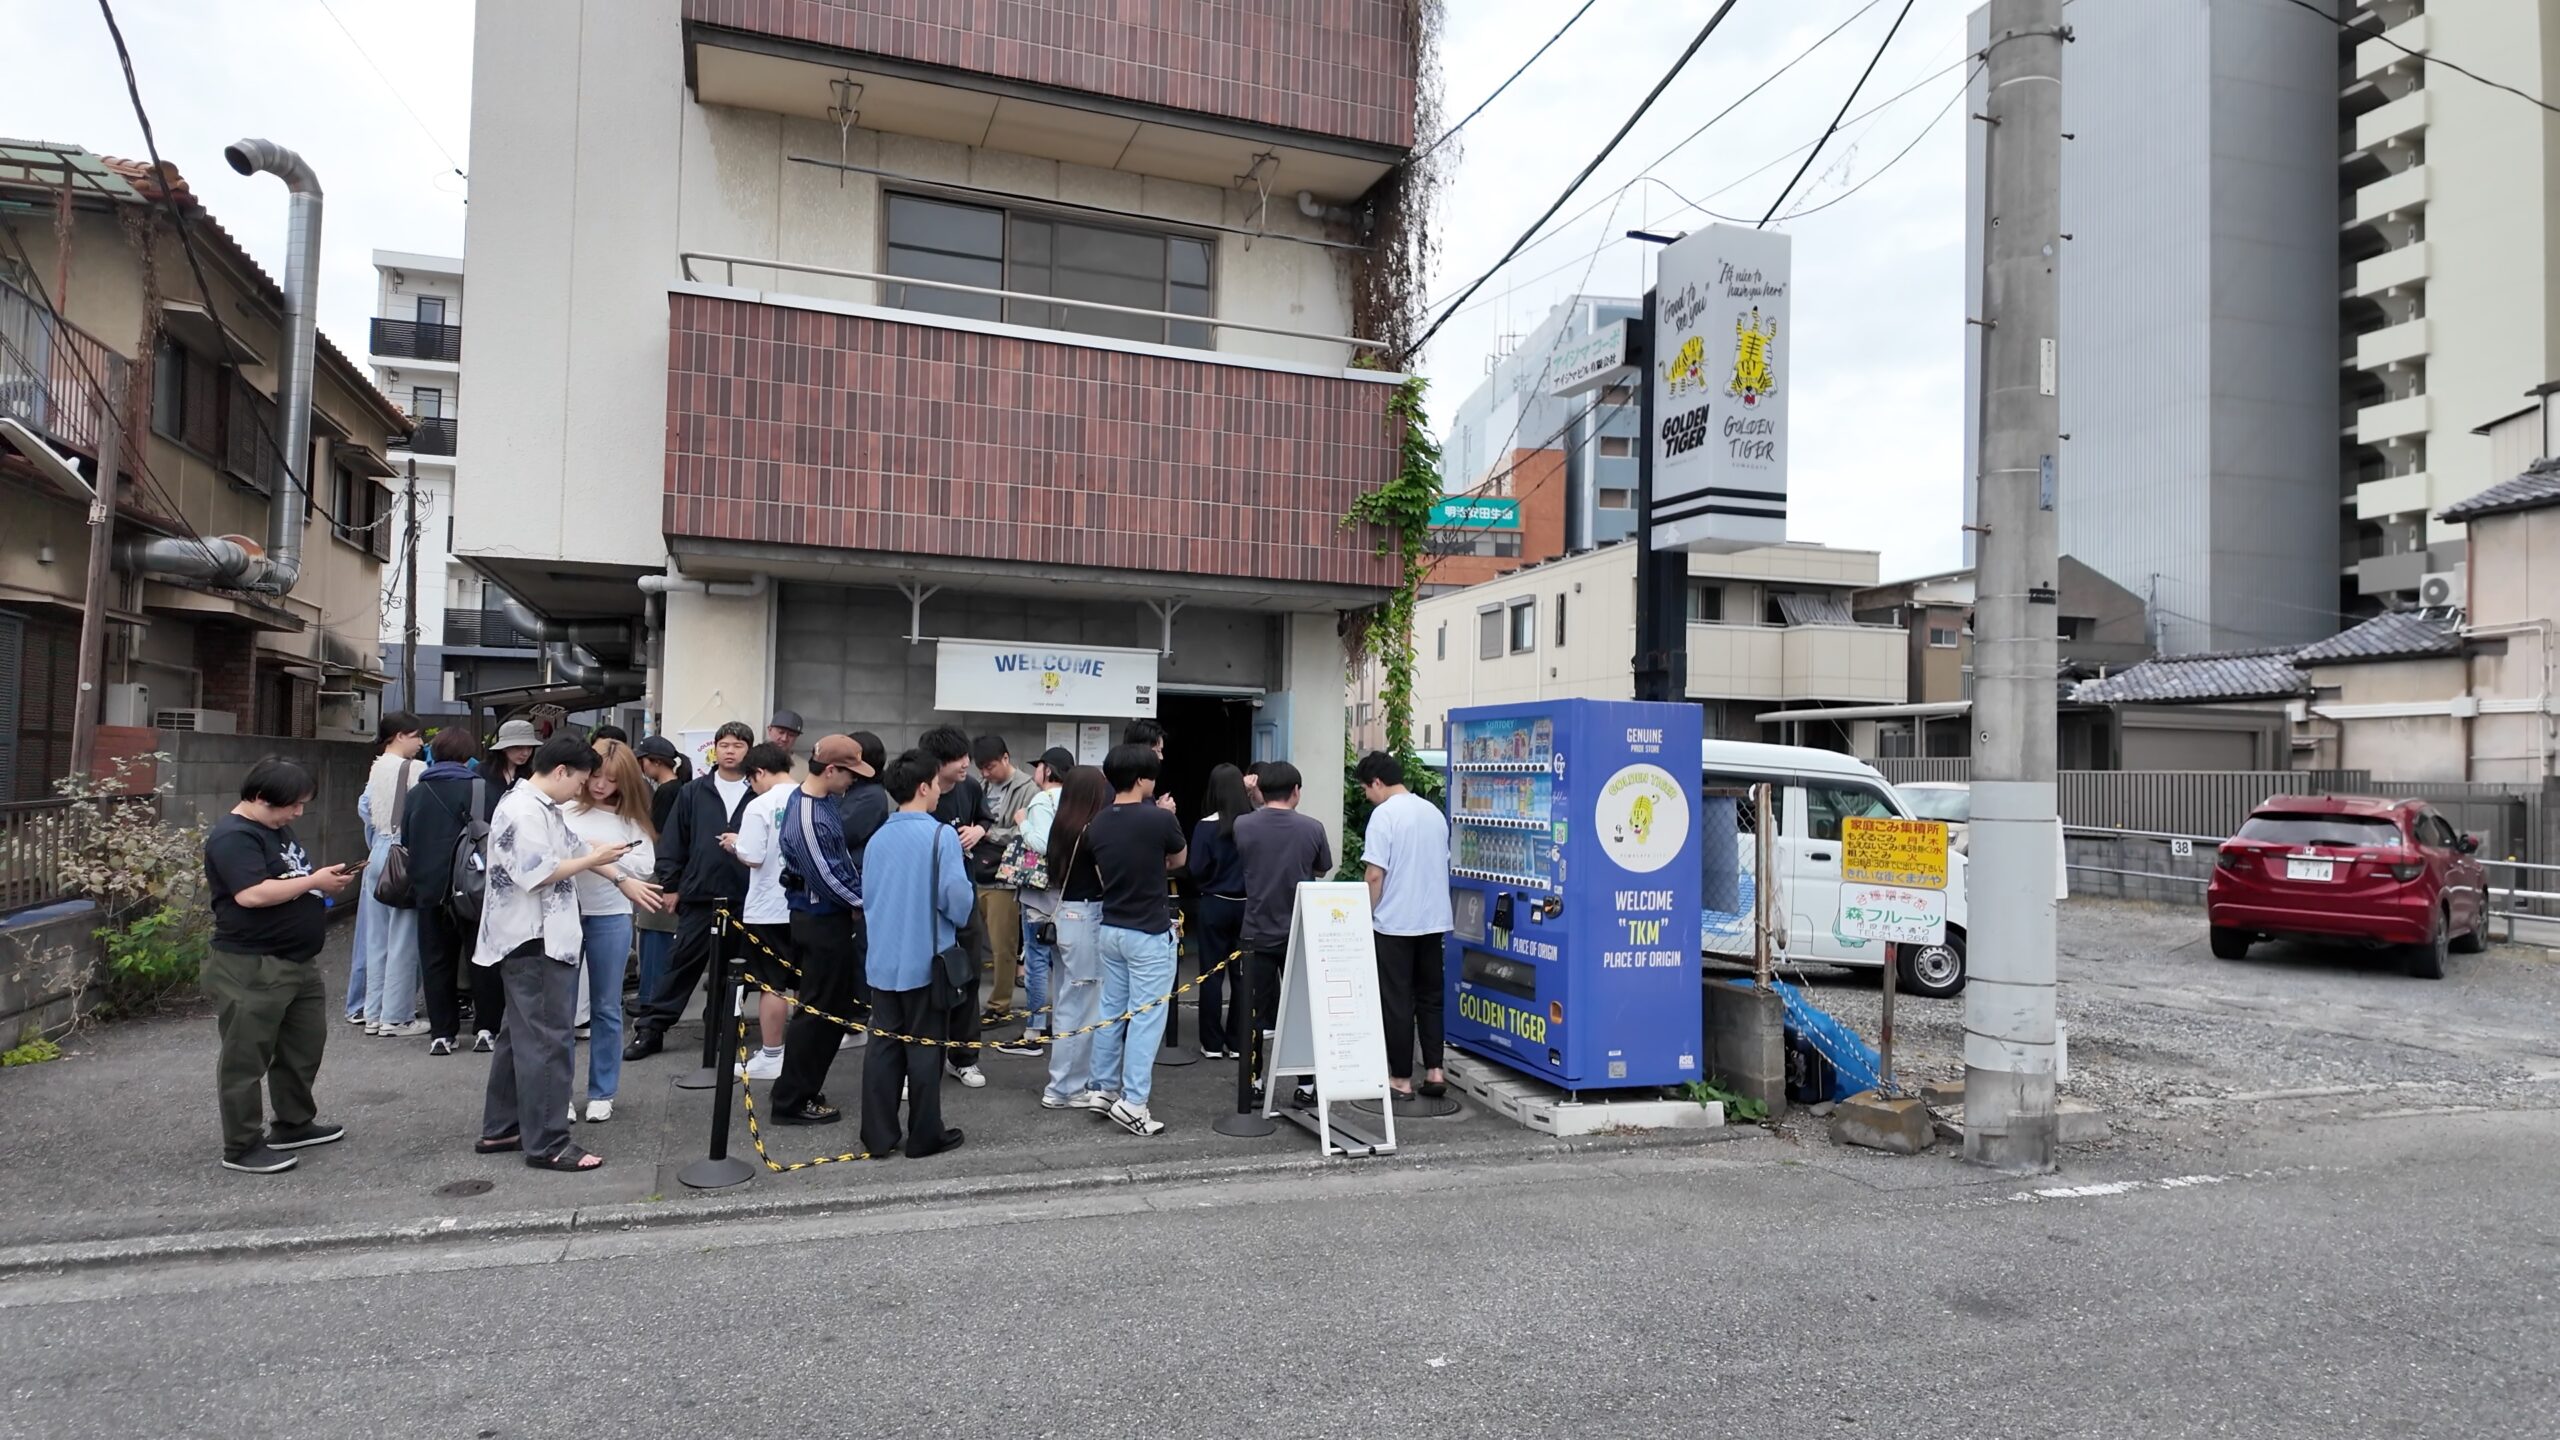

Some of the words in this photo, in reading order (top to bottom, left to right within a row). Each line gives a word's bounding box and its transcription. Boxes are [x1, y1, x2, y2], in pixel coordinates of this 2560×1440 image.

[1735, 268, 1752, 282] nice
[1753, 268, 1762, 283] to
[1687, 281, 1696, 307] to
[1662, 403, 1710, 440] GOLDEN
[1723, 416, 1774, 437] GOLDEN
[1665, 425, 1706, 459] TIGER
[1729, 438, 1775, 462] TIGER
[995, 653, 1105, 678] WELCOME
[1626, 727, 1663, 744] GENUINE
[1608, 772, 1649, 796] GOLDEN
[1651, 773, 1678, 800] TIGER
[1847, 832, 1896, 842] もえるごみ
[1850, 820, 1939, 835] 家庭ごみ集積所
[1847, 841, 1898, 851] もえないごみ
[1847, 850, 1891, 860] 粗大ごみ
[1907, 853, 1917, 861] 火
[2175, 841, 2188, 854] 38
[1615, 890, 1674, 911] WELCOME
[1845, 906, 1941, 928] 森フルーツ
[1513, 937, 1529, 955] PLACE
[1529, 941, 1537, 957] OF
[1537, 943, 1558, 961] ORIGIN
[1603, 952, 1633, 968] PLACE
[1634, 951, 1648, 968] OF
[1649, 951, 1681, 967] ORIGIN
[1460, 992, 1505, 1031] GOLDEN
[1508, 1007, 1546, 1045] TIGER
